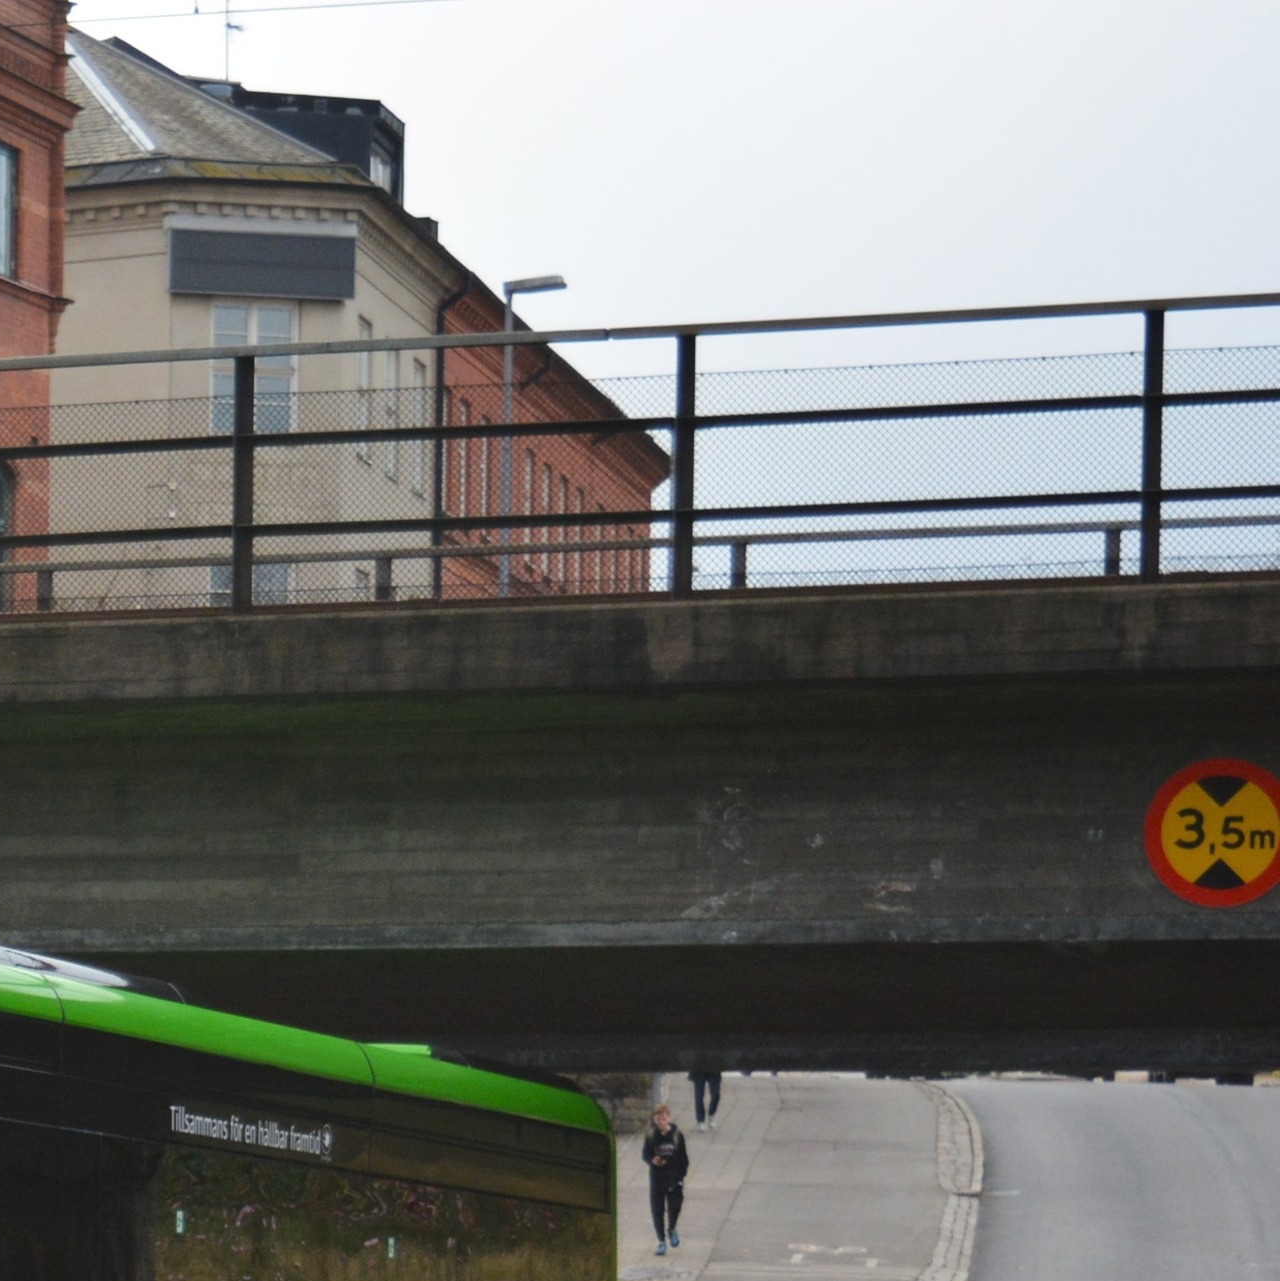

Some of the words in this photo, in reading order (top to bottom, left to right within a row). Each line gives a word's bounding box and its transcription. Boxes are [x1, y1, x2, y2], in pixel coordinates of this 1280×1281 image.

[170, 1106, 228, 1139] Tillsammans
[231, 1115, 243, 1142] för
[245, 1124, 256, 1145] en
[290, 1125, 321, 1155] framtid
